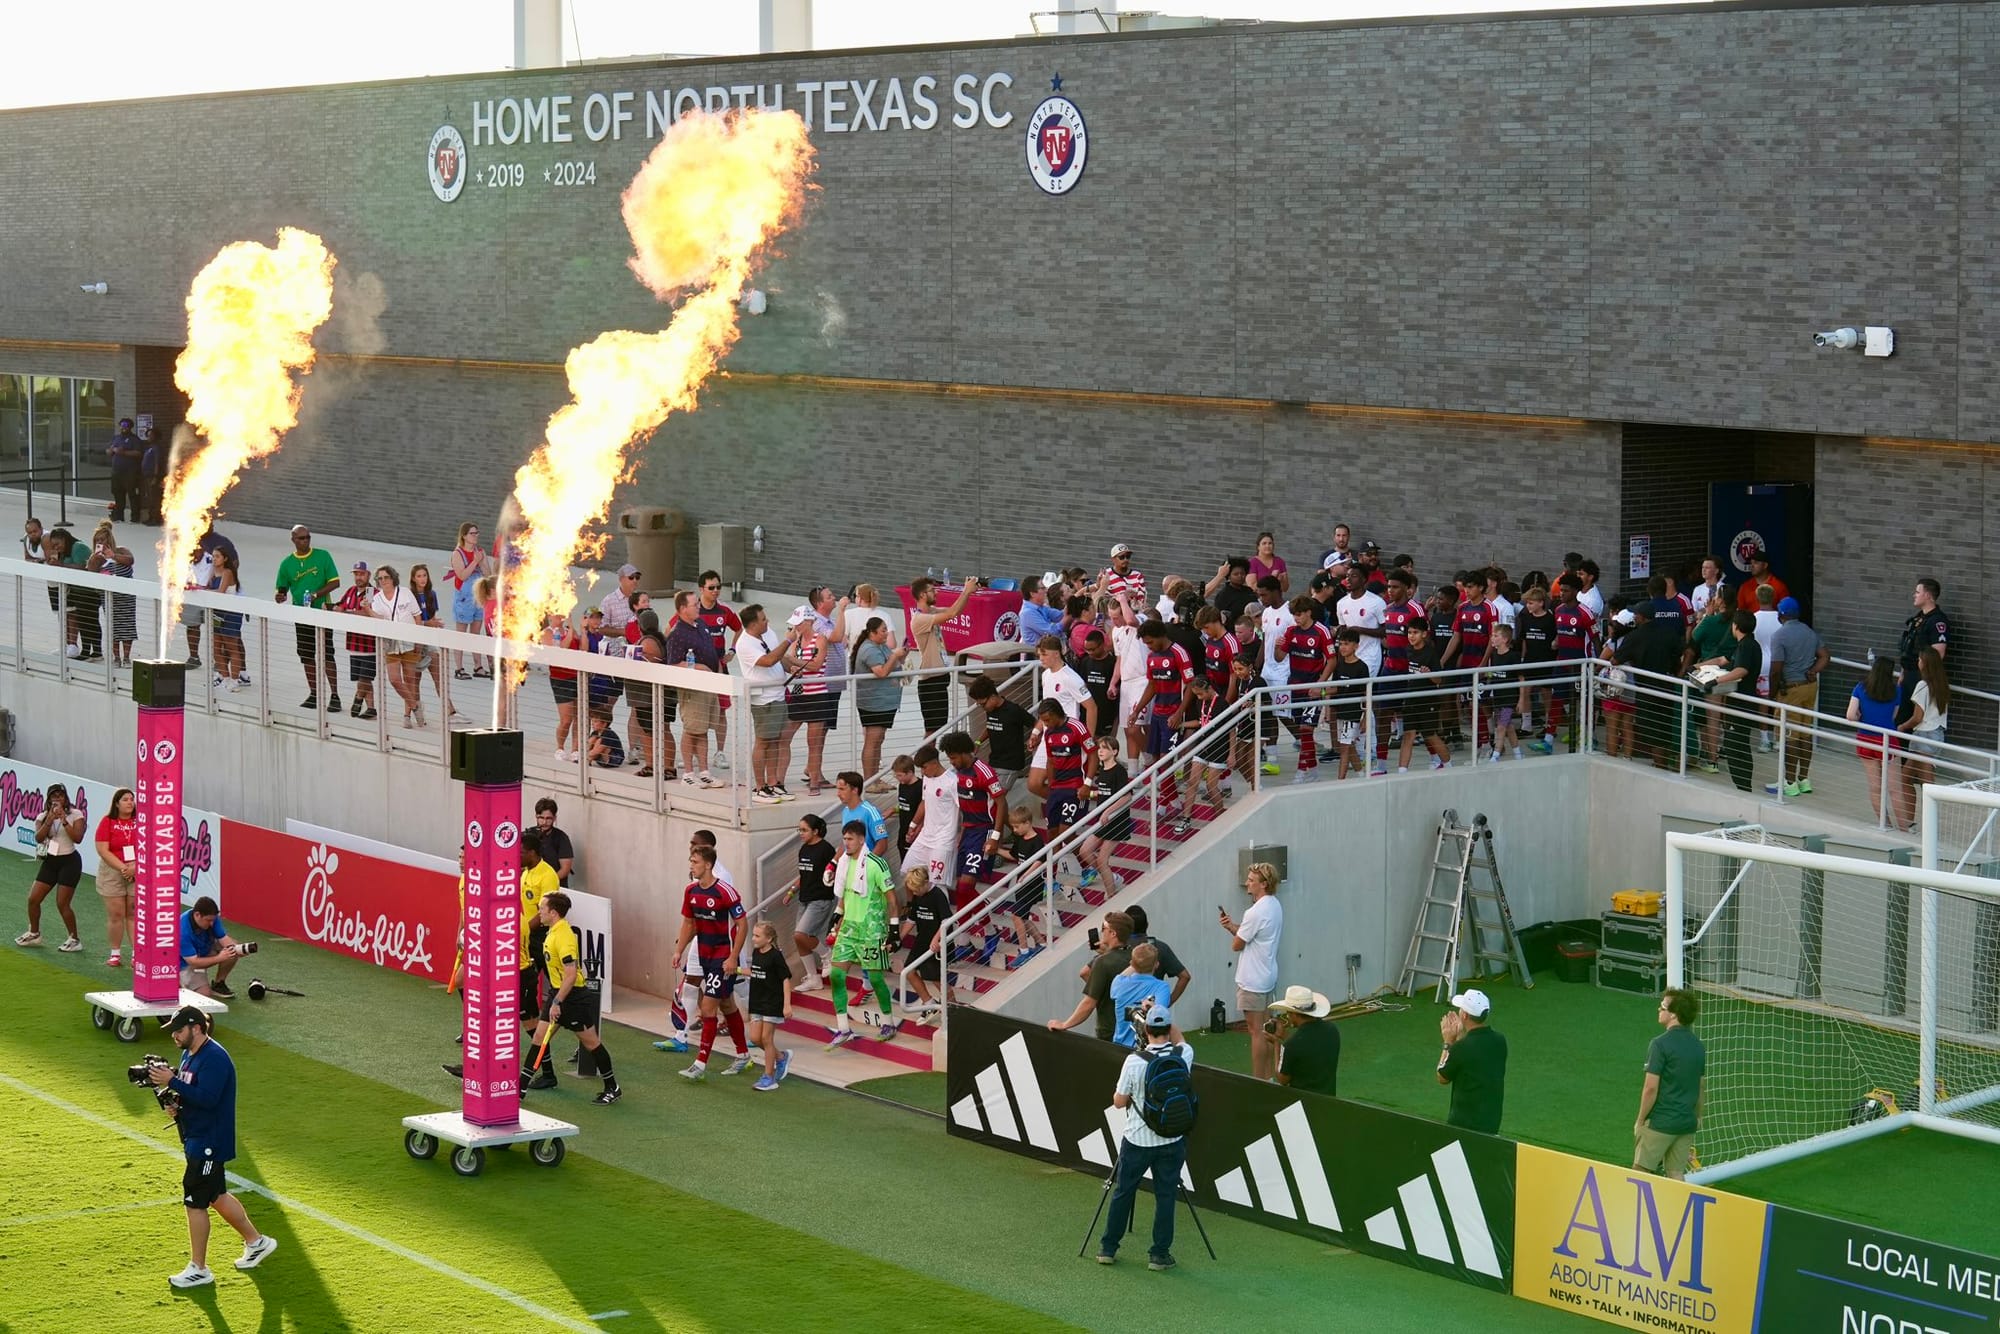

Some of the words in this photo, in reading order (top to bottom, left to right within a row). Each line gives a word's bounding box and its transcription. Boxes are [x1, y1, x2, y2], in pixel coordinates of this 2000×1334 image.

[473, 95, 572, 147] HOME
[583, 91, 635, 142] OF
[796, 75, 939, 133] TEXAS
[952, 71, 1014, 129] SC
[1029, 103, 1054, 141] NORTH
[1060, 102, 1084, 141] TEXAS
[487, 163, 525, 188] 2019
[554, 160, 597, 187] 2024
[1050, 178, 1063, 191] SC
[137, 779, 147, 804] SC
[155, 781, 175, 805] SC
[1061, 802, 1078, 817] 29
[137, 812, 147, 875] TEXAS
[155, 814, 175, 878] TEXAS
[965, 852, 982, 868] 22
[468, 867, 481, 896] SC
[495, 868, 516, 897] SC
[930, 860, 945, 874] 79
[136, 884, 147, 946] NORTH
[155, 886, 175, 948] NORTH
[468, 906, 481, 978] TEXAS
[495, 906, 516, 981] TEXAS
[862, 947, 879, 961] 13
[706, 972, 722, 989] 26
[467, 988, 481, 1061] NORTH
[494, 989, 516, 1061] NORTH
[1552, 1166, 1717, 1295] AM
[1847, 1238, 1939, 1287] LOCAL
[1549, 1262, 1613, 1295] ABOUT
[1617, 1279, 1717, 1323] MANSFIELD
[1549, 1287, 1583, 1306] NEWS
[1592, 1299, 1622, 1317] TALK
